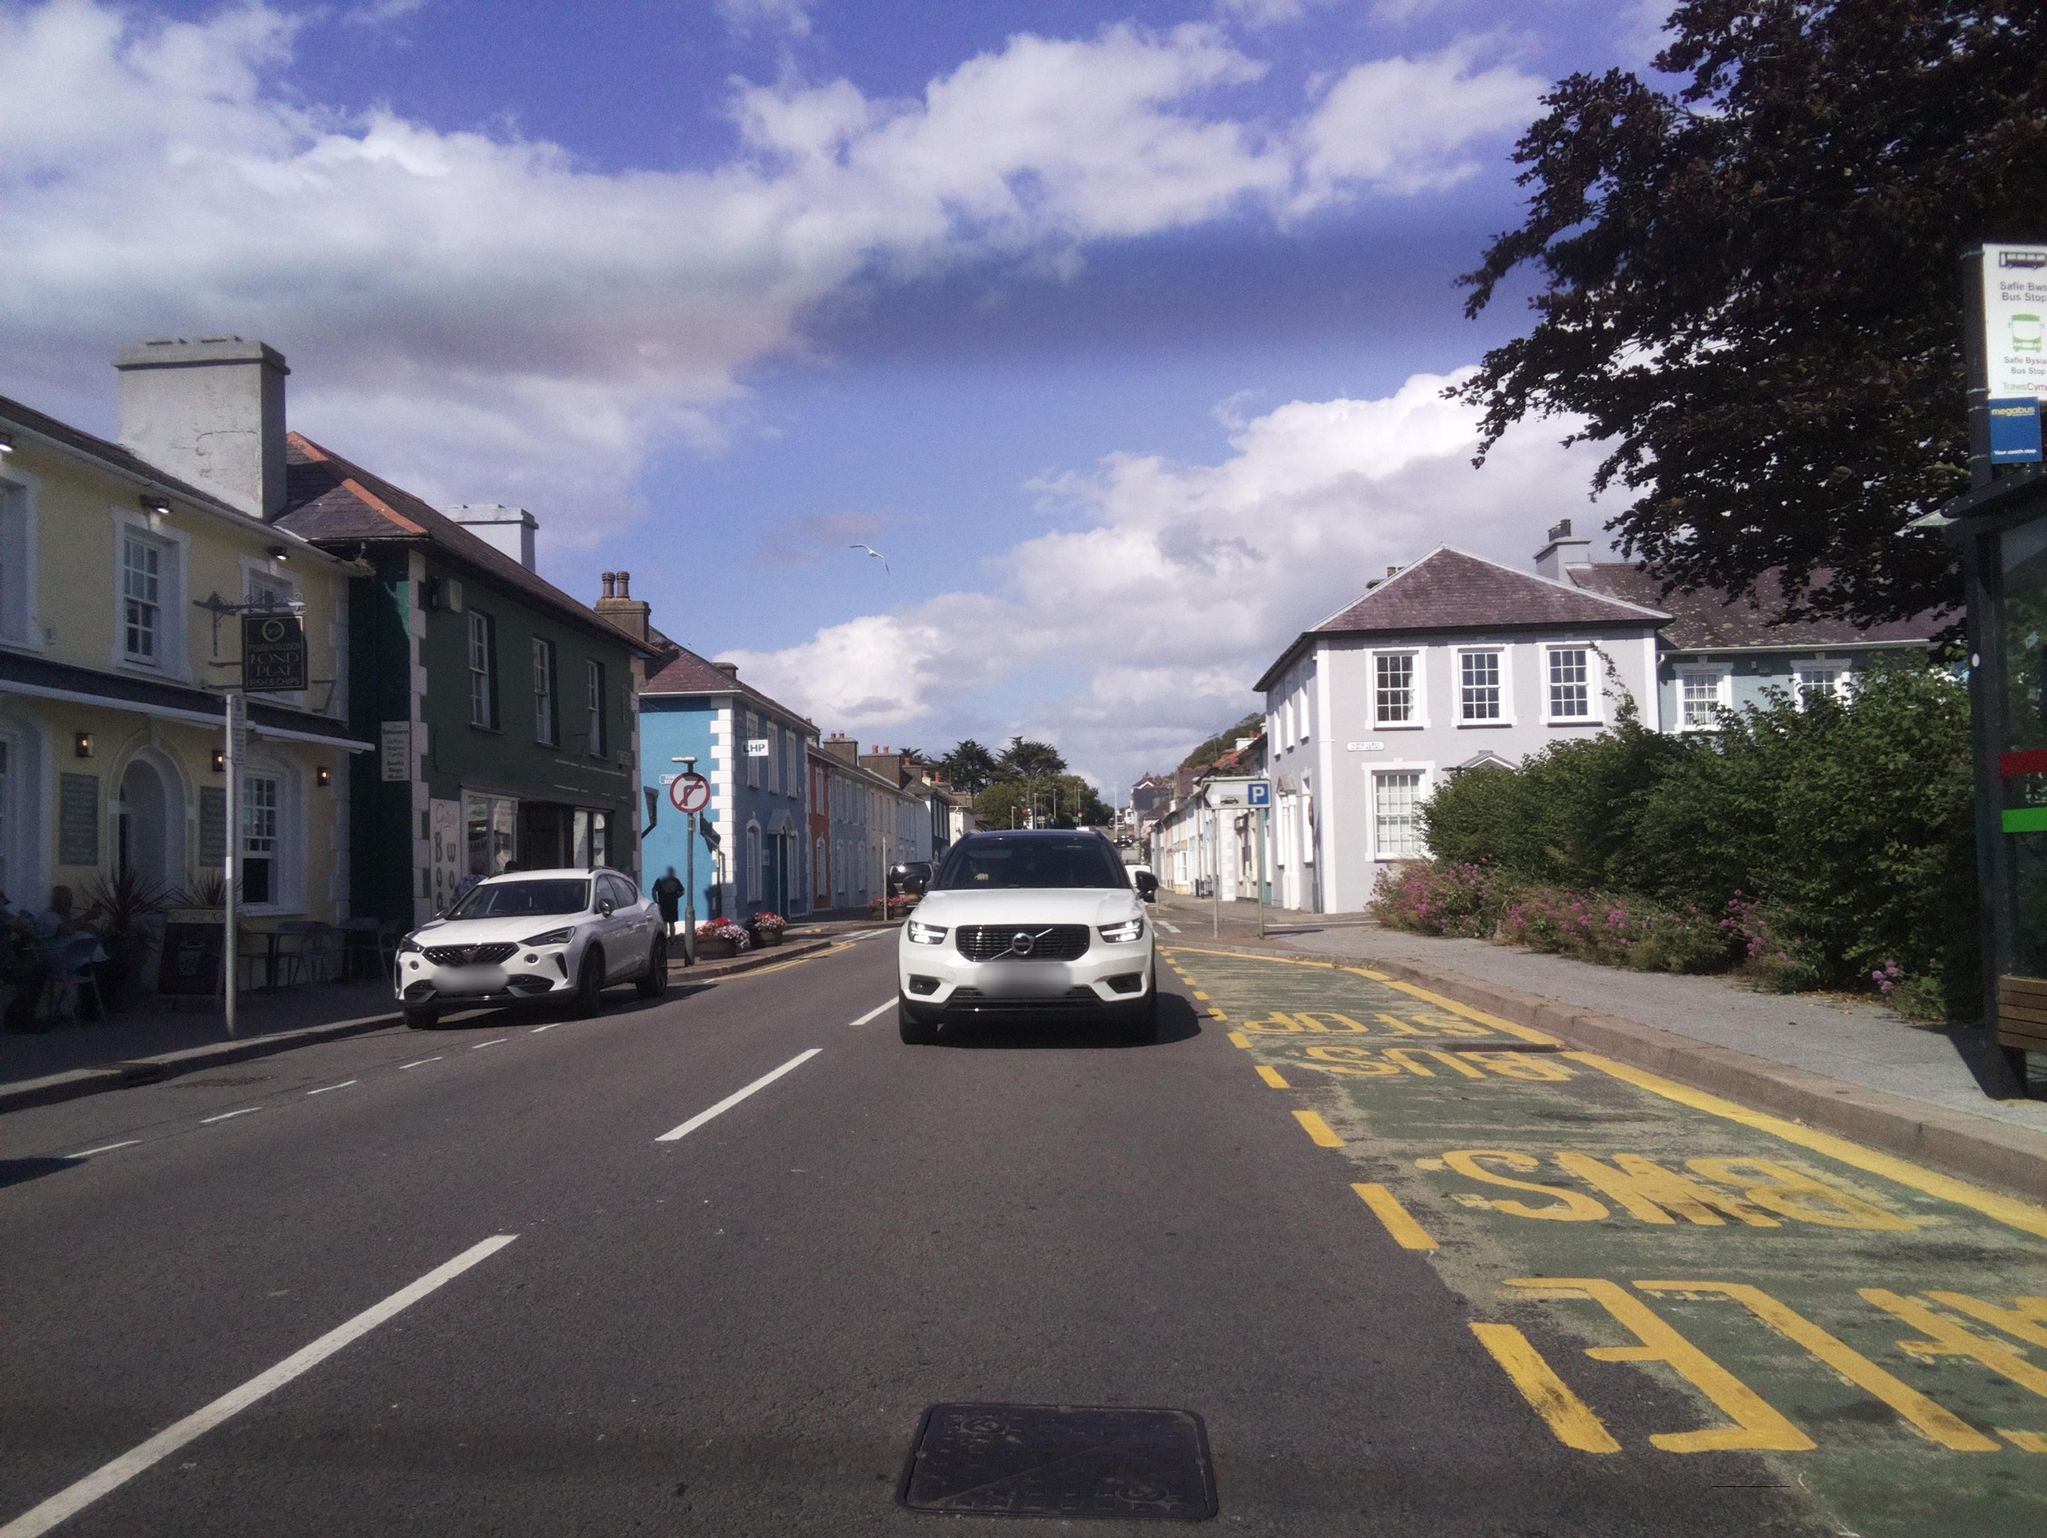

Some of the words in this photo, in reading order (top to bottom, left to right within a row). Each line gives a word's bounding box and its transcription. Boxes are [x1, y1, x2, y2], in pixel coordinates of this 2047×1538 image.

[2000, 281, 2025, 291] Safle
[2002, 292, 2021, 301] Bus
[2024, 293, 2047, 303] Stop
[2025, 356, 2047, 365] Bysia
[2011, 367, 2026, 375] Bus
[2028, 367, 2046, 376] Stop
[2003, 382, 2047, 392] TrawsCym
[1992, 406, 2036, 416] megabus
[743, 743, 766, 753] LHP
[1252, 785, 1266, 803] P
[1243, 1011, 1497, 1037] STOP
[1305, 1045, 1573, 1081] BUS
[1418, 1150, 1922, 1230] BWS
